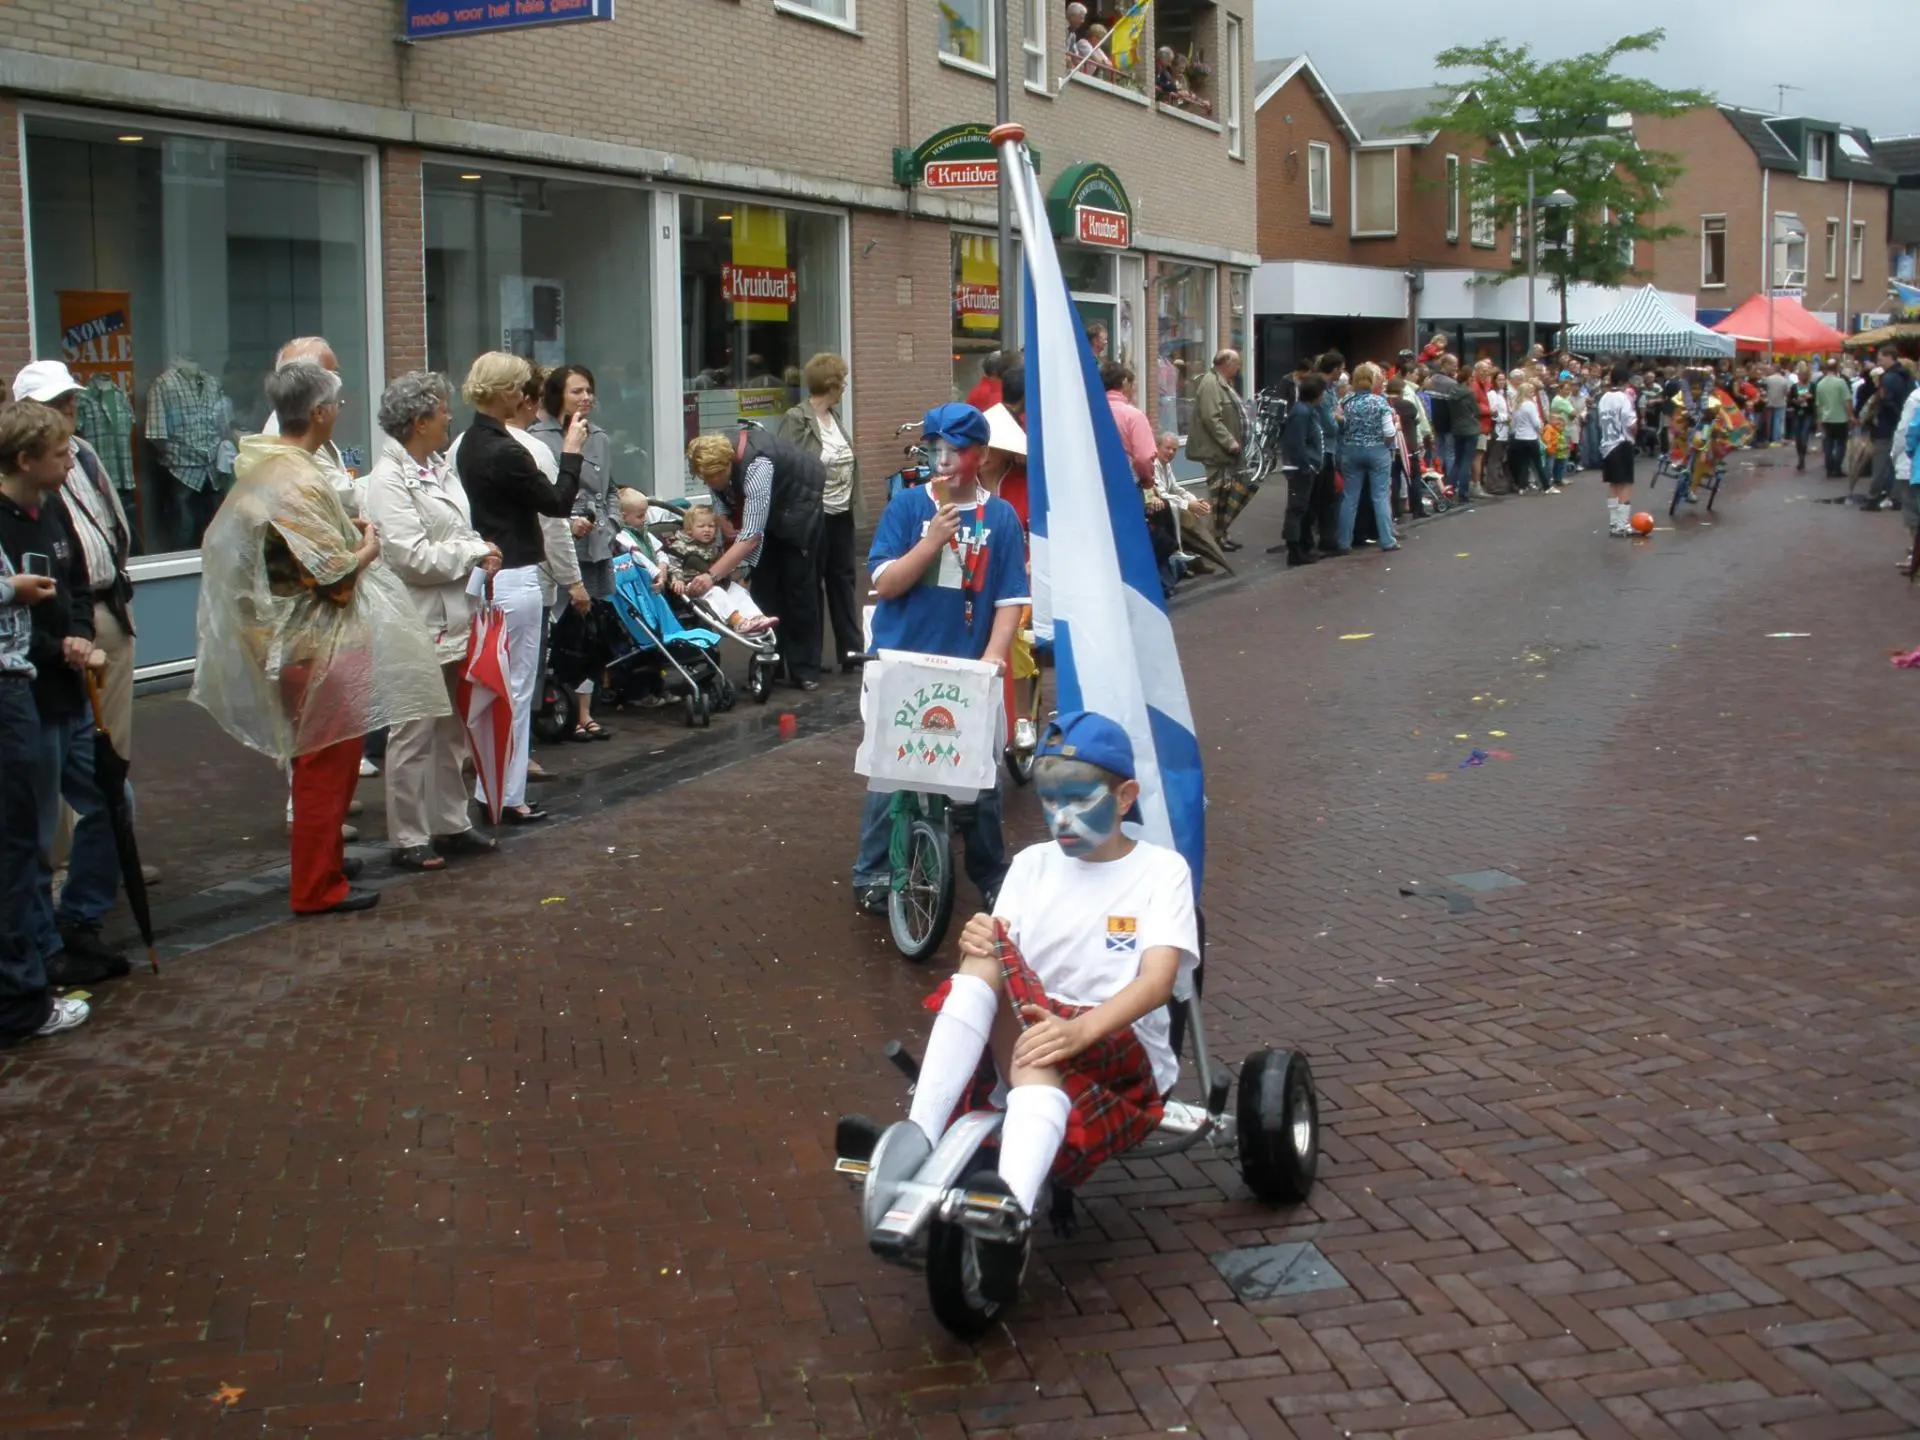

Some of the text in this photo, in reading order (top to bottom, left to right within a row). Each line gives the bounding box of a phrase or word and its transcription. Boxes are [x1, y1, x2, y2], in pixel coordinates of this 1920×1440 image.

[412, 10, 449, 27] mode
[454, 8, 483, 22] voor
[488, 2, 510, 17] het
[938, 166, 999, 183] Kruidva
[1089, 215, 1118, 238] Kruidvat
[733, 269, 788, 298] Kruidvat
[963, 287, 999, 310] Kruidvat
[62, 335, 132, 362] SALE
[921, 520, 991, 546] ILY
